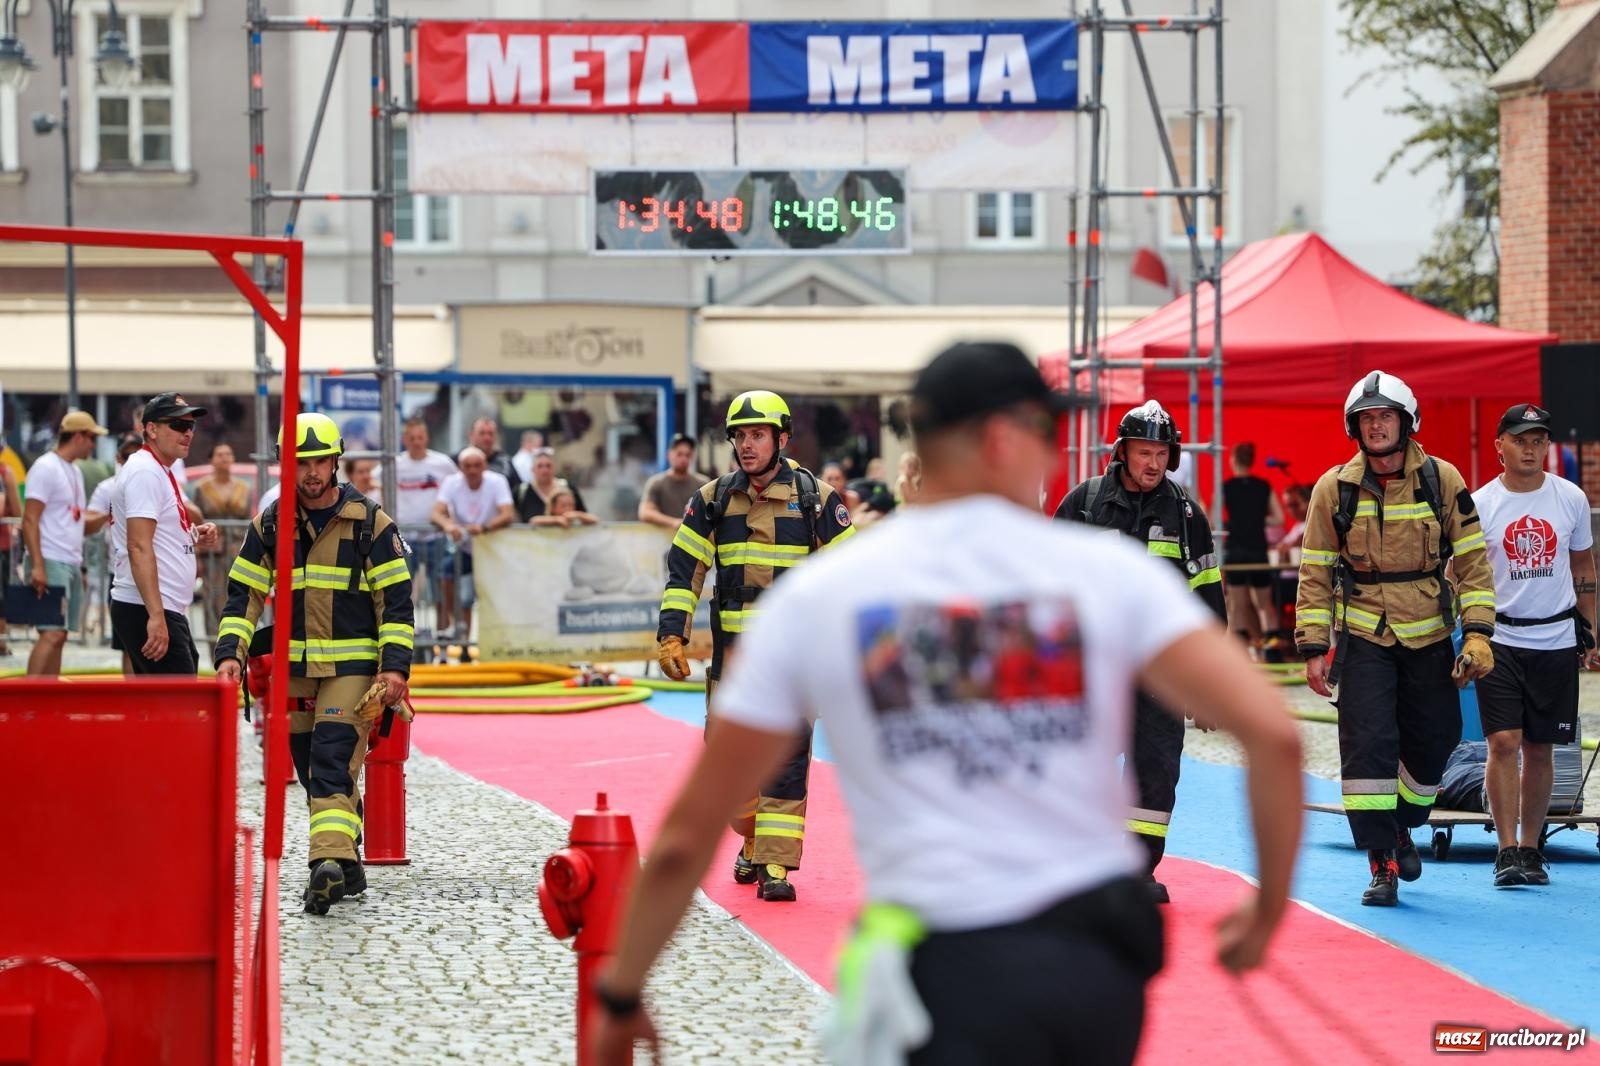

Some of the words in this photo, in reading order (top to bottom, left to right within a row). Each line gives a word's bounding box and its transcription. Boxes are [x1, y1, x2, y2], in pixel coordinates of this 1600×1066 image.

[465, 34, 698, 107] META
[806, 34, 1038, 105] META
[617, 198, 743, 233] 1:34.48
[774, 198, 896, 232] 1:48.46
[565, 607, 648, 628] hurtownia
